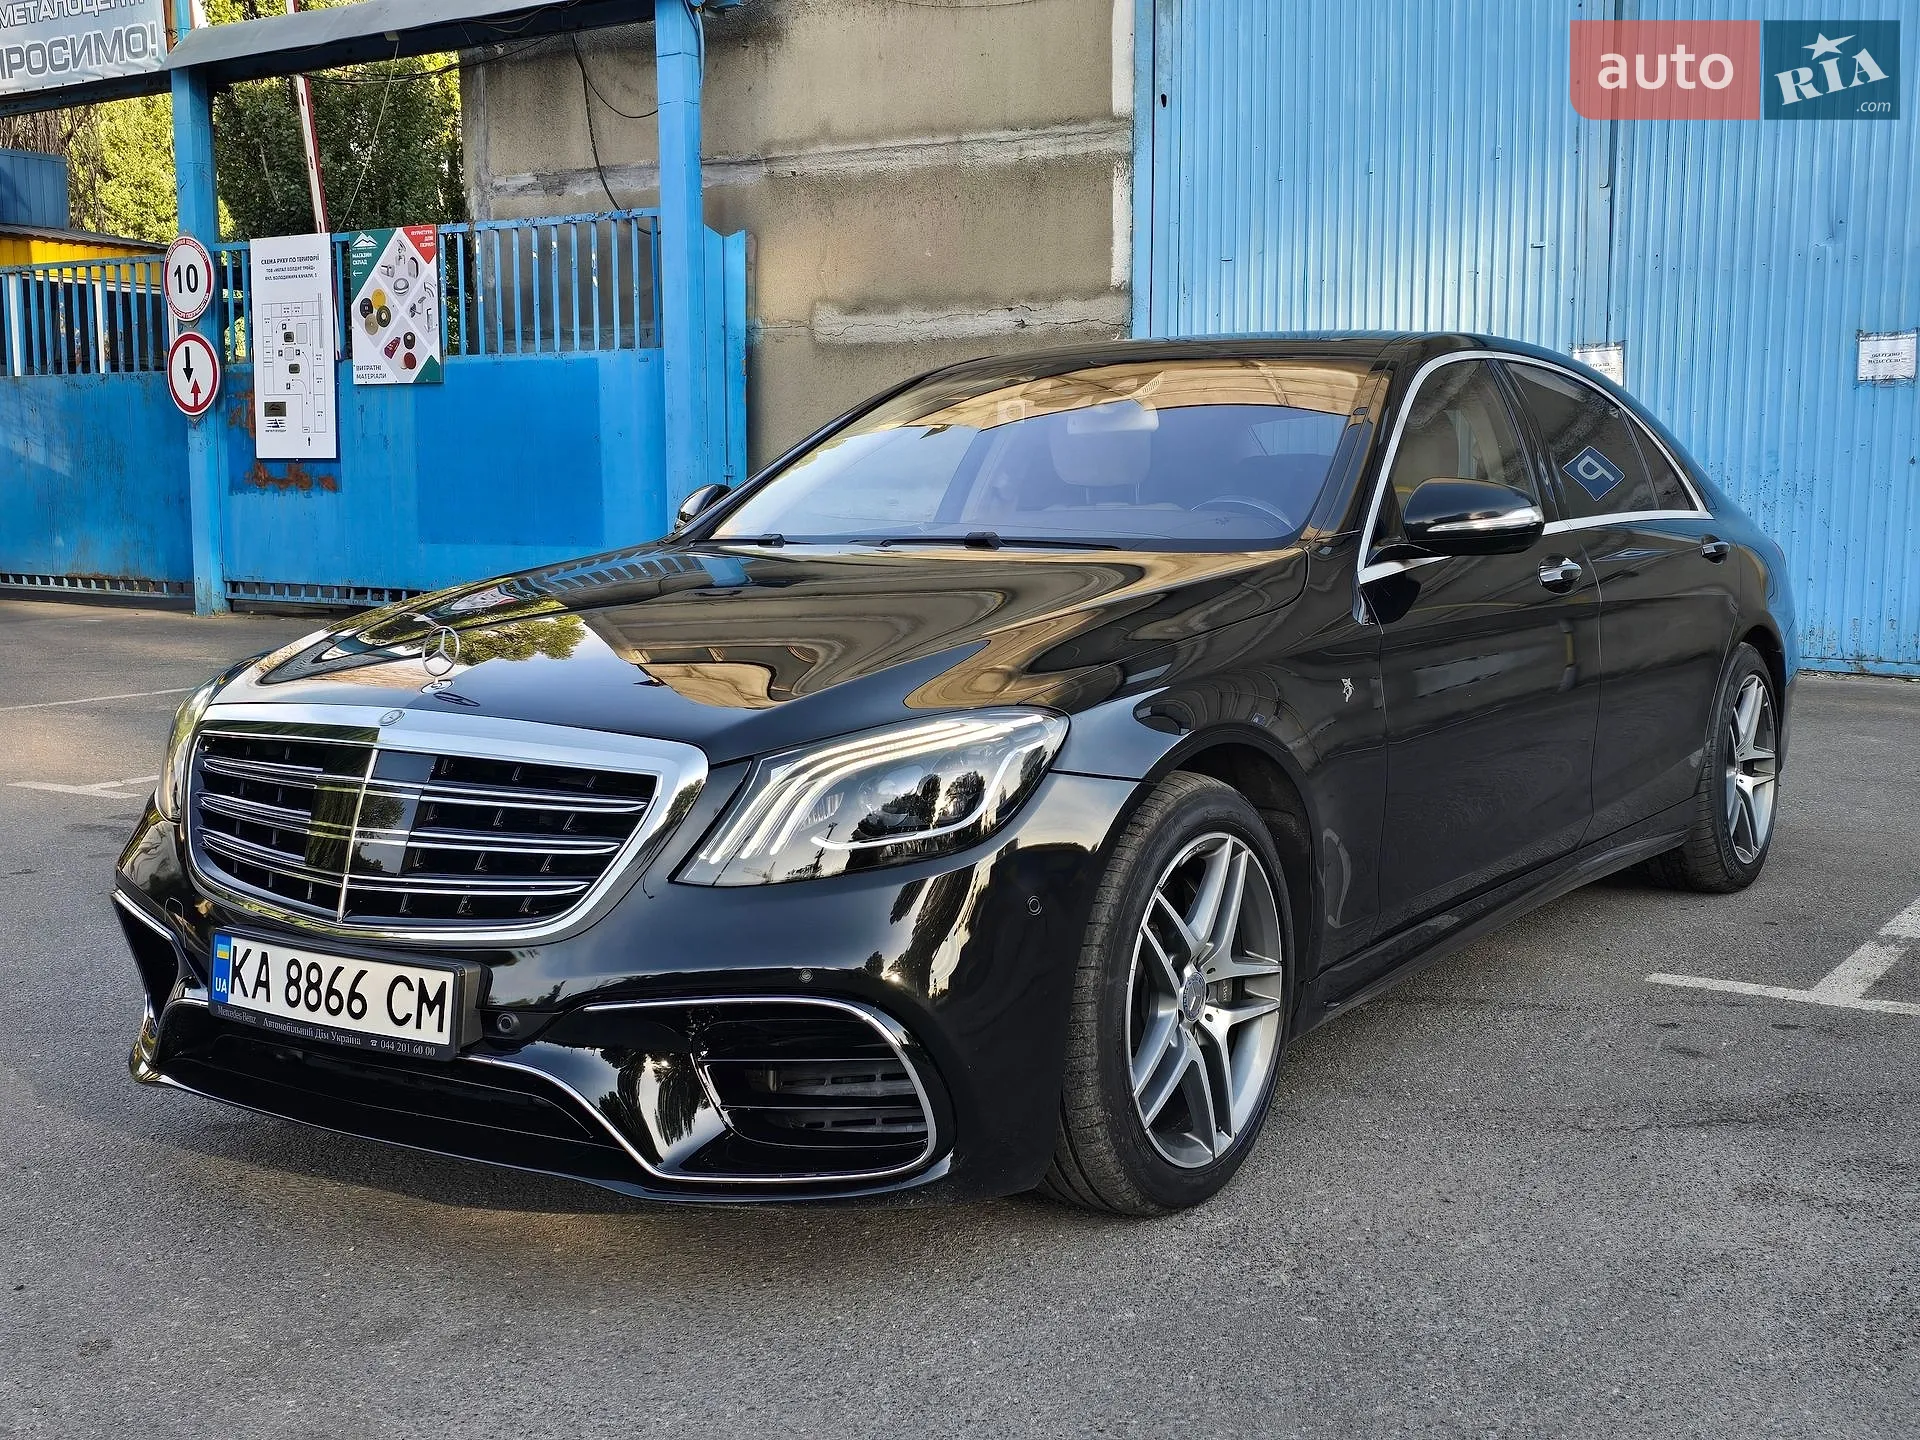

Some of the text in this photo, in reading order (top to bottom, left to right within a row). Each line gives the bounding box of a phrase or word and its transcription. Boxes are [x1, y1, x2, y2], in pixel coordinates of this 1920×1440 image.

[0, 0, 144, 28] МЕТАЛОЦЕ
[174, 264, 198, 294] 10
[215, 977, 228, 995] UA
[230, 945, 447, 1033] KA 8866 CM
[263, 1017, 361, 1046] Автомобільний Дім Україна
[380, 1040, 435, 1056] 044 201 60 00
